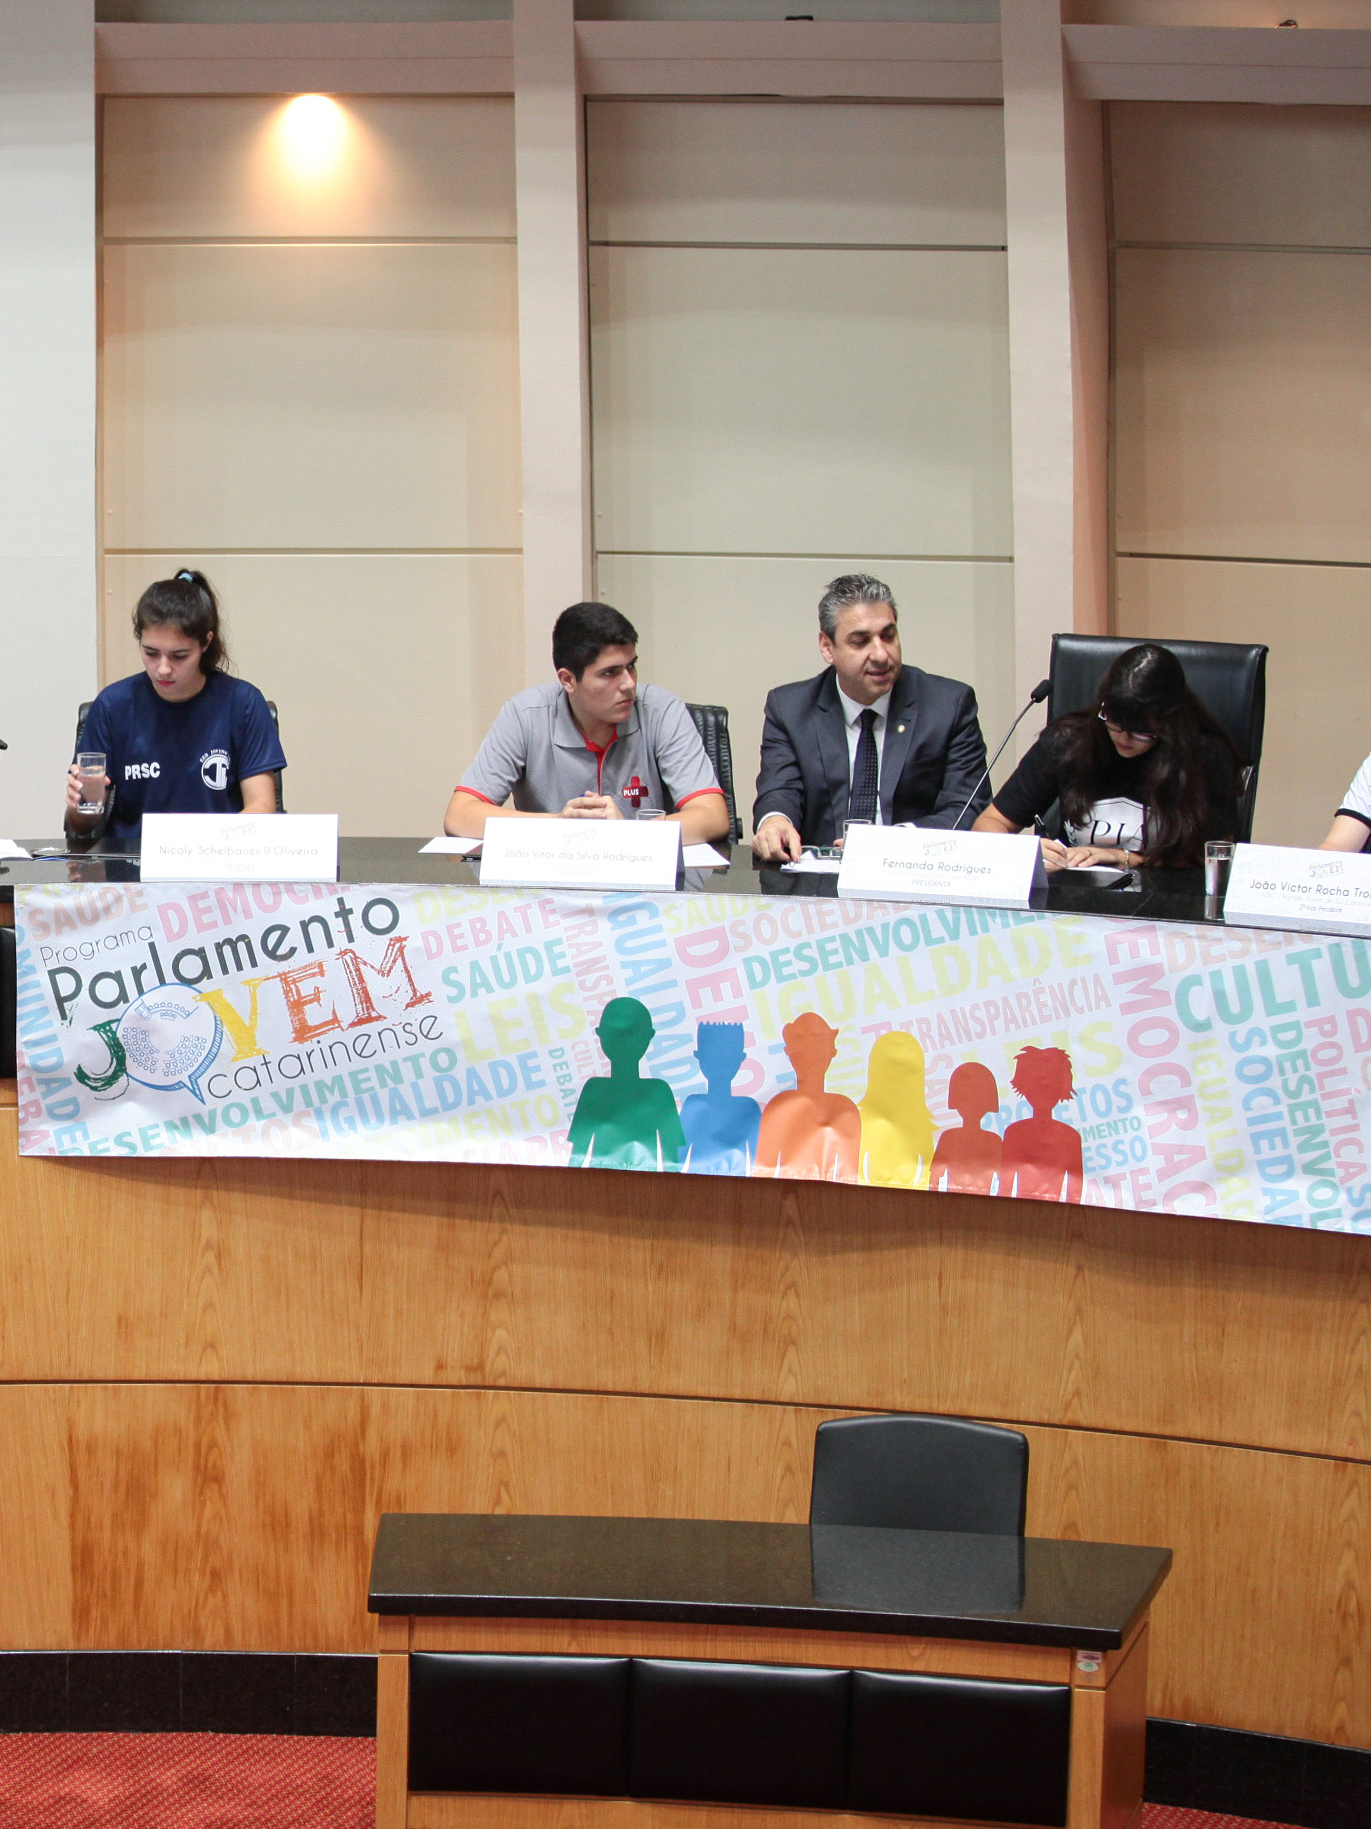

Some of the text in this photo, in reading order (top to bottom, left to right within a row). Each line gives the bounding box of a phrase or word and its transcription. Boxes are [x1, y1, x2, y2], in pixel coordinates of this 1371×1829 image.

[124, 761, 161, 781] PRSC
[623, 788, 640, 797] PLUS
[159, 845, 193, 857] Nicoly
[504, 848, 529, 859] João
[558, 850, 573, 860] da
[577, 851, 600, 861] Silva
[603, 851, 653, 863] Rodrigues
[882, 857, 934, 871] Fernanda
[937, 860, 993, 876] Rodrigues
[911, 879, 952, 889] PRESIDENTA
[1249, 878, 1277, 890] João
[1280, 880, 1313, 894] Victor
[1315, 884, 1350, 897] Rocha
[39, 924, 154, 968] Programa
[46, 896, 401, 1022] Parlamento
[420, 897, 565, 962] DEBATE
[440, 937, 572, 1005] SAÚDE
[752, 914, 1095, 1042] IGUALDADE
[452, 980, 588, 1066] LEIS
[899, 976, 1113, 1052] TRANSPARÊNCIA
[207, 1014, 444, 1099] catarinense
[313, 1050, 547, 1143] IGUALDADE
[1303, 1014, 1369, 1185] POLÍTICA
